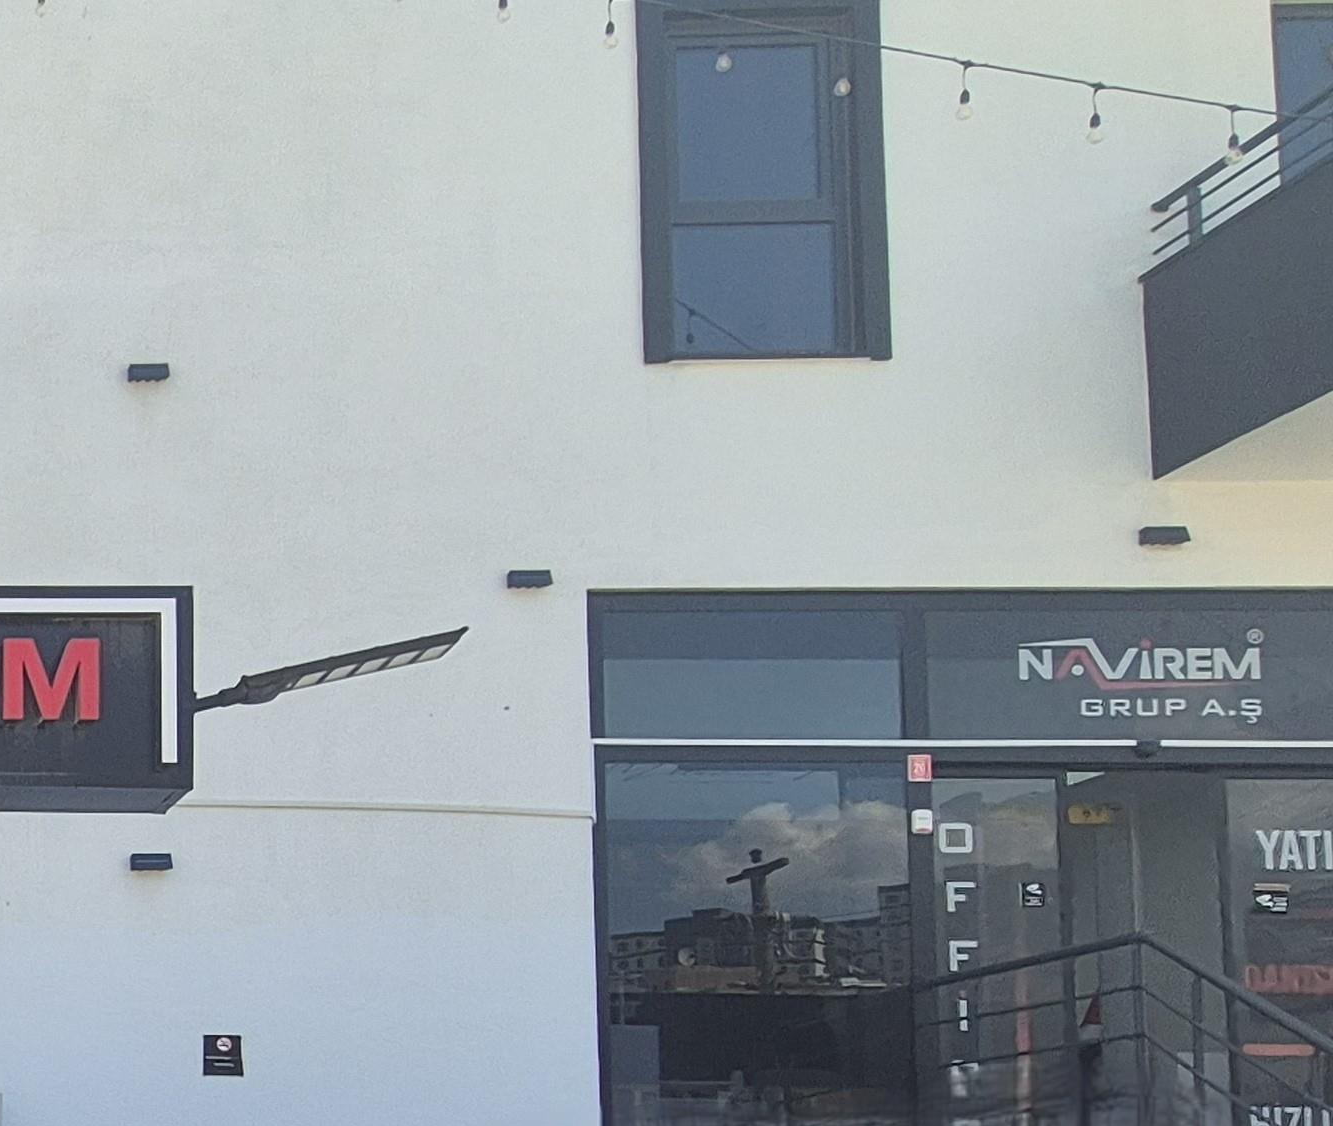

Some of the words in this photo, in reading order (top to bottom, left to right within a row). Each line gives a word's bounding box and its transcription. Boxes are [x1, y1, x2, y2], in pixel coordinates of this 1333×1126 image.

[1081, 698, 1186, 717] GRUP
[1201, 698, 1262, 724] A.Ş
[1255, 829, 1333, 870] YATI
